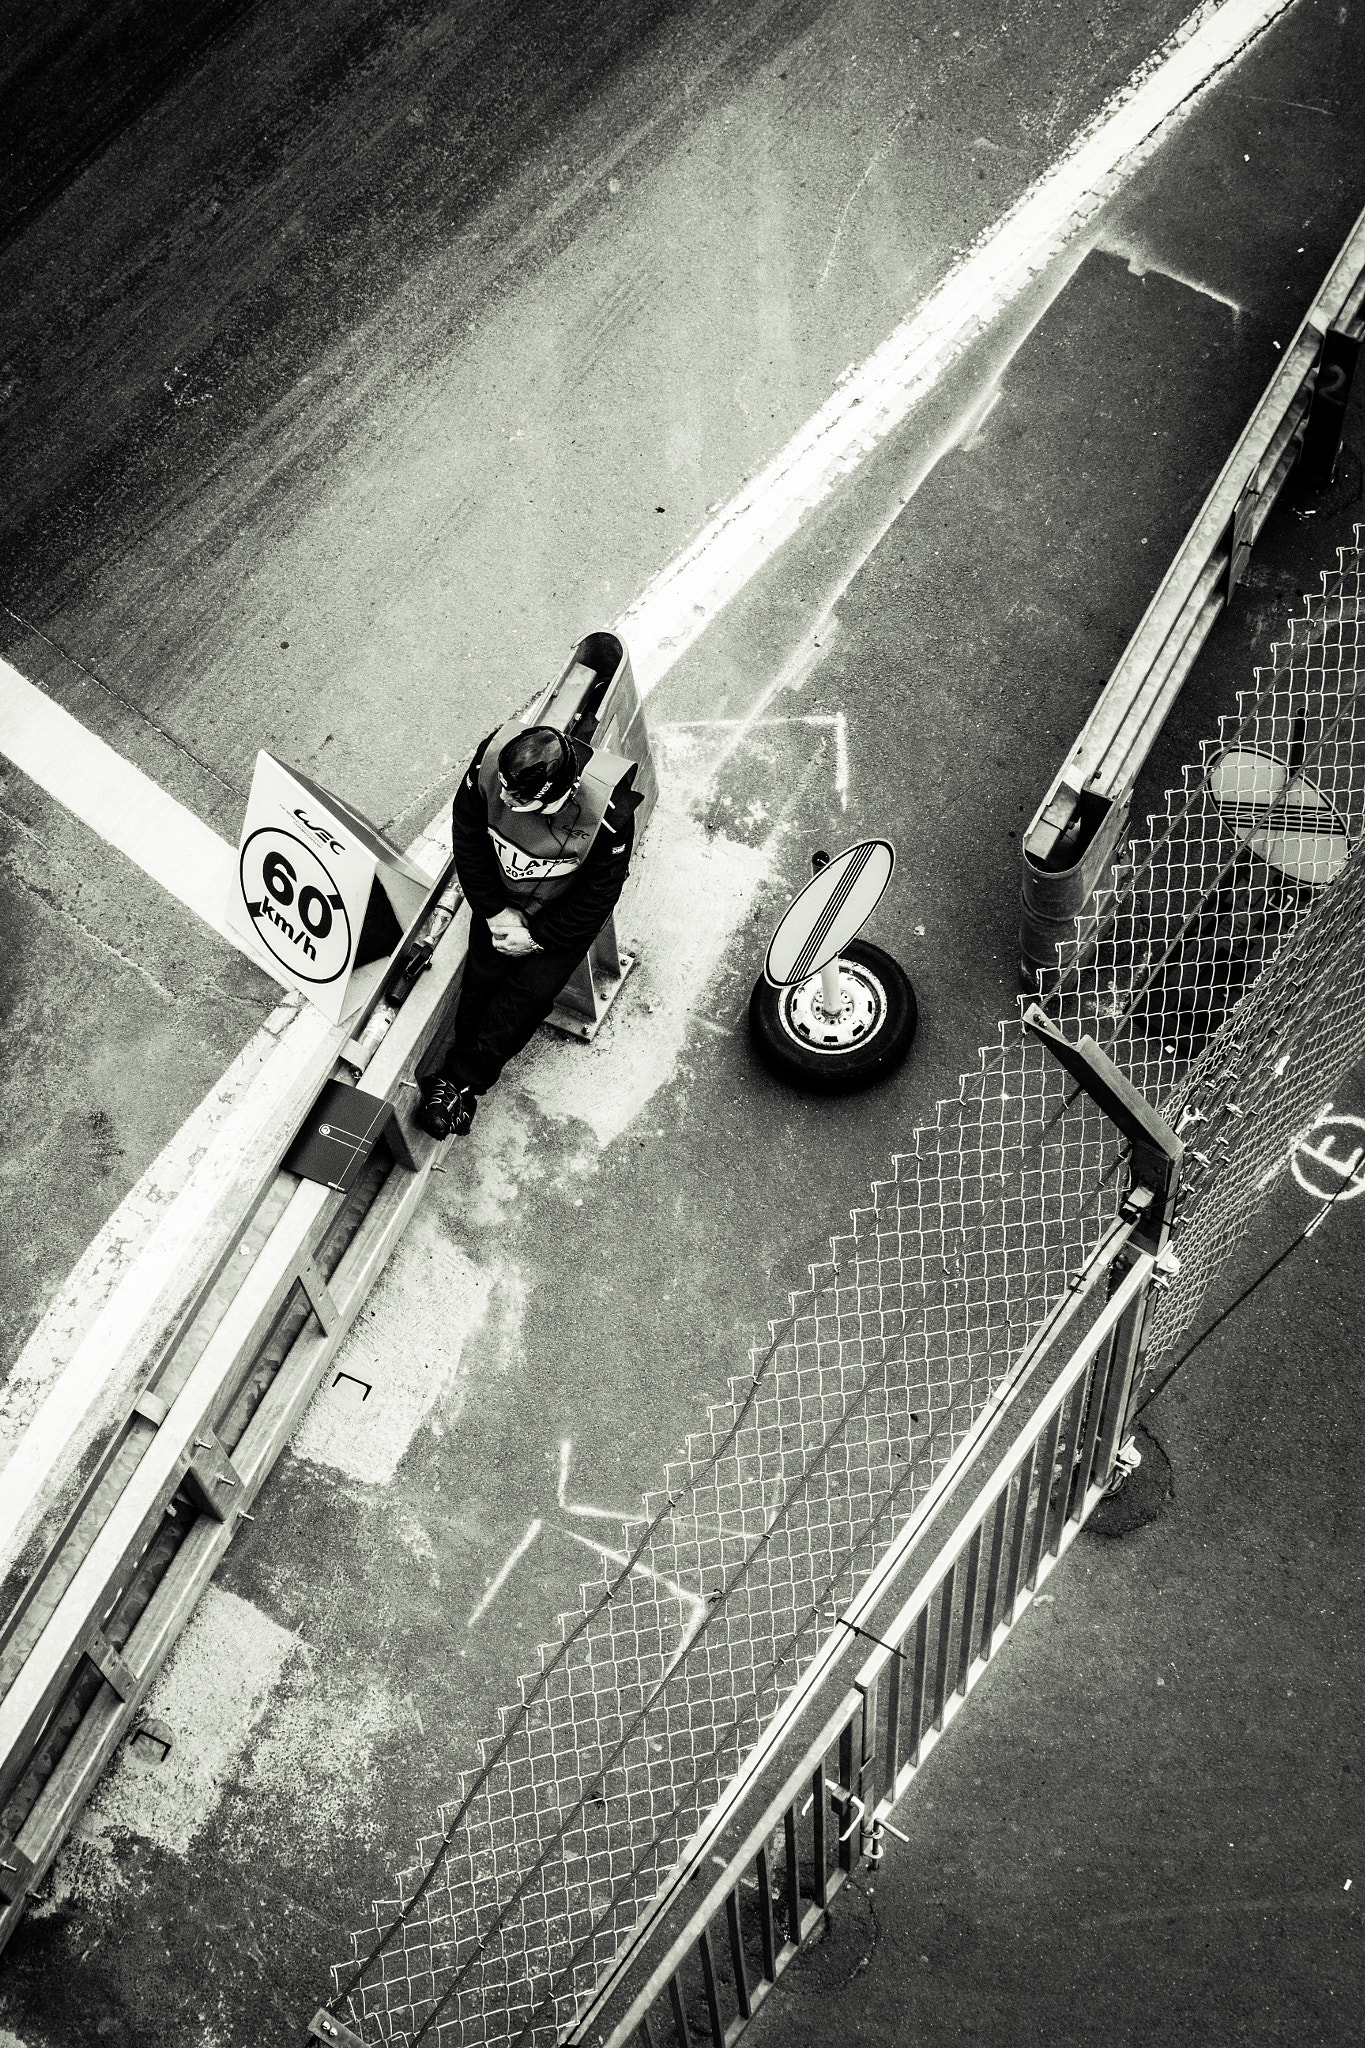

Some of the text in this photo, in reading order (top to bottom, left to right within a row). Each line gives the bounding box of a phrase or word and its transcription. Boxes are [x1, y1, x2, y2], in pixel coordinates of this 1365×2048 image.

[262, 851, 333, 939] 60
[505, 865, 534, 878] 2016
[261, 896, 317, 962] km/h
